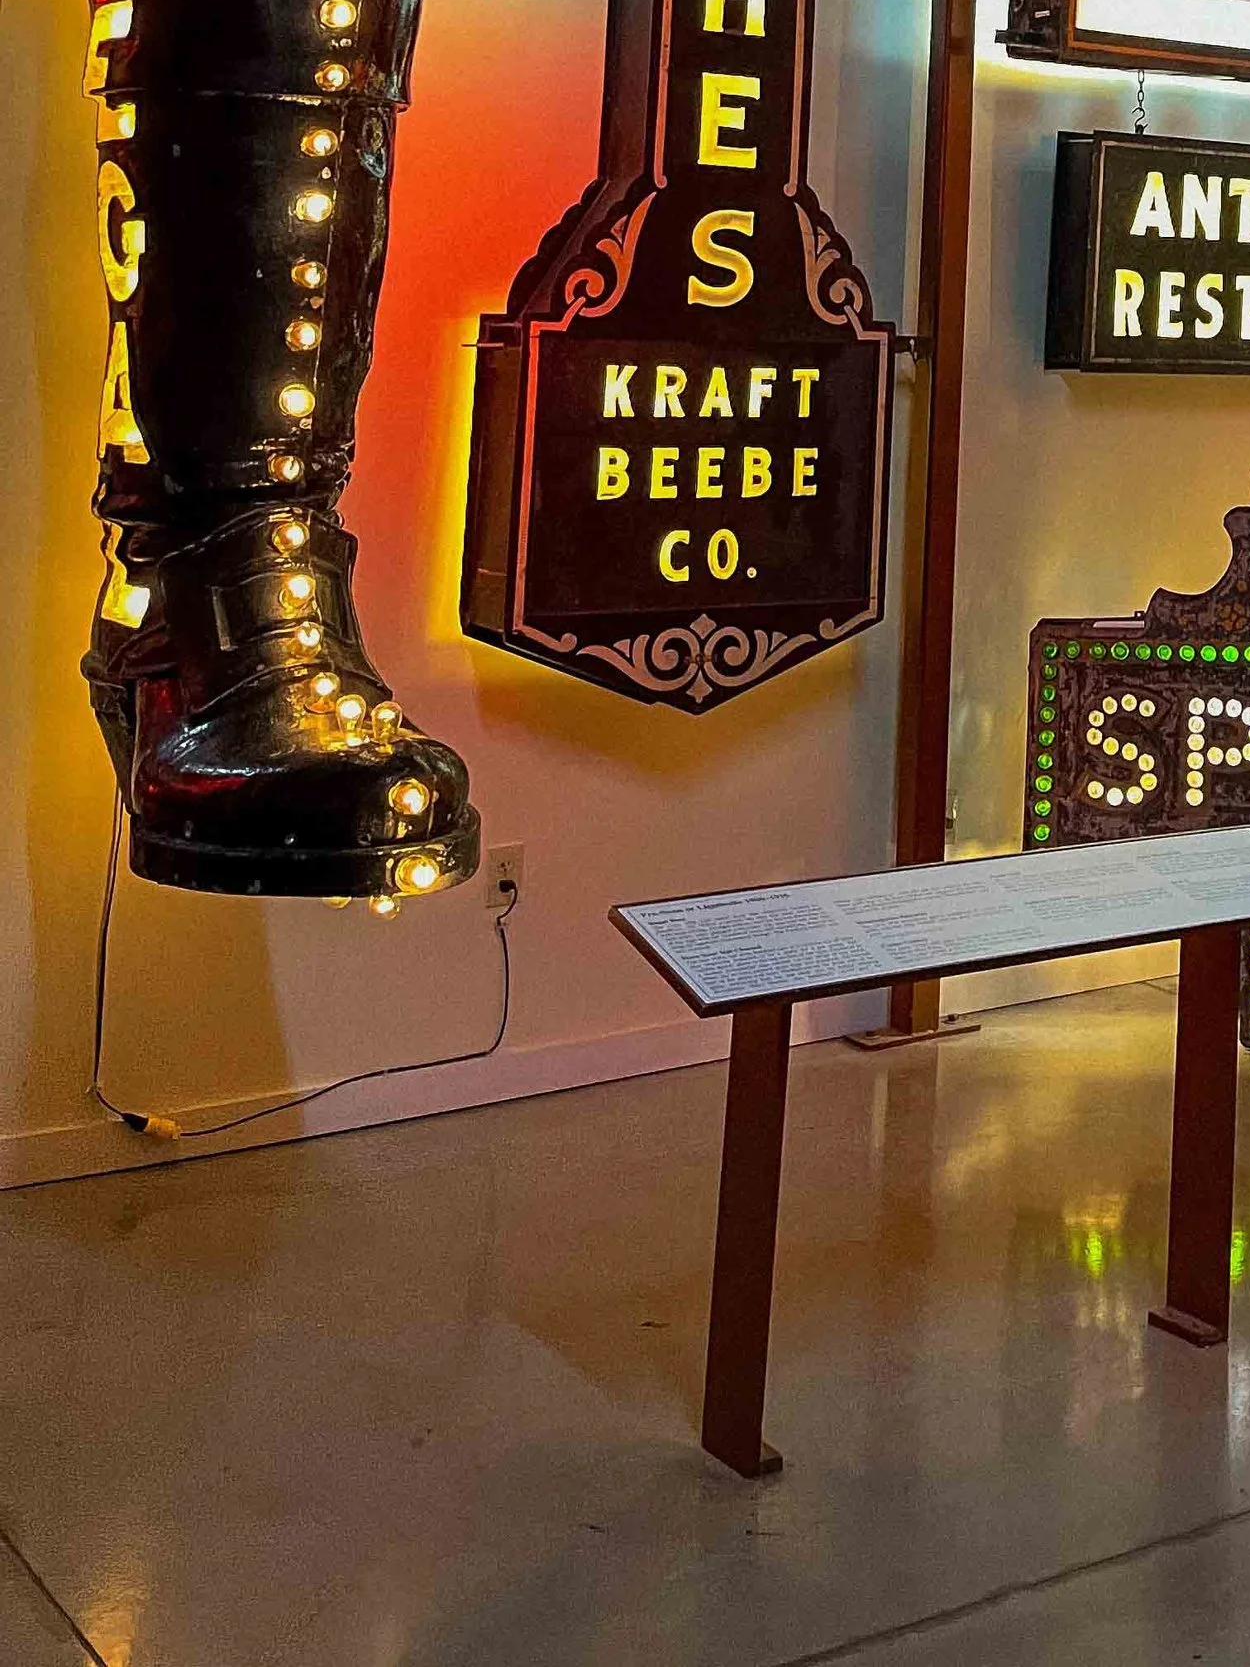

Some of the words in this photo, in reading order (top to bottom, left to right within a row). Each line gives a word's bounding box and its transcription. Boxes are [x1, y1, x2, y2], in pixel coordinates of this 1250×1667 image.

[603, 365, 820, 418] KRAFT
[596, 446, 819, 501] BEEBE
[659, 528, 758, 582] CO.
